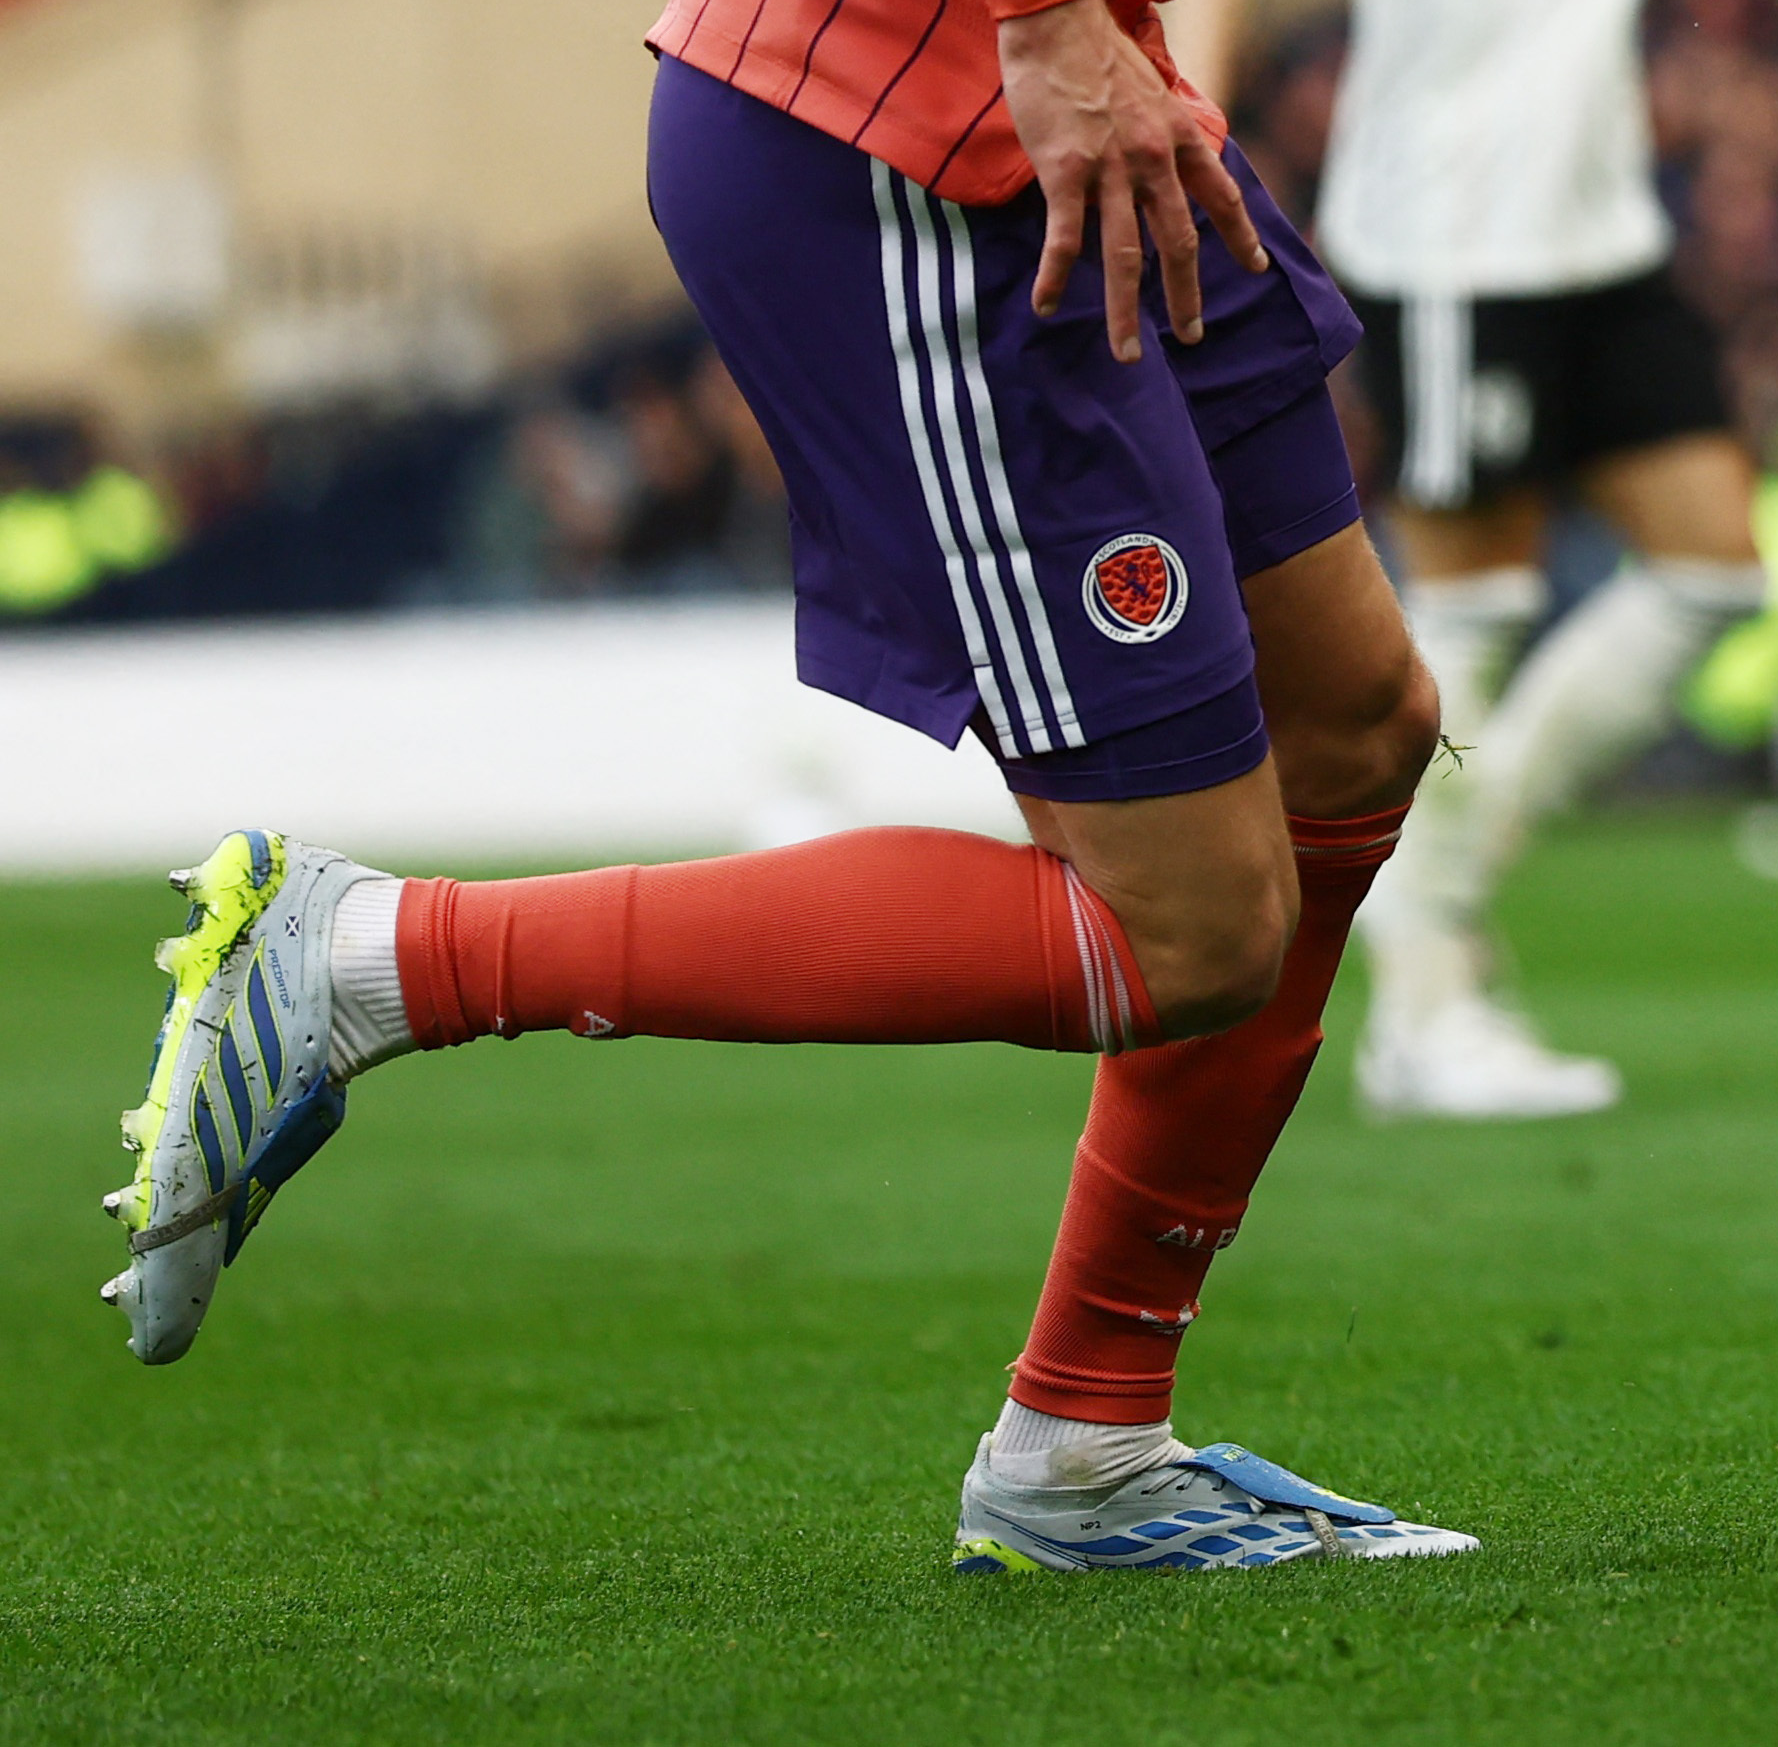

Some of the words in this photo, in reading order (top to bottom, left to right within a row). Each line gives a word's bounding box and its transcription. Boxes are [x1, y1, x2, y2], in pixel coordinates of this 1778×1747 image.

[1098, 536, 1149, 558] SCOTLAND
[268, 948, 291, 1009] PREDATOR
[1080, 1520, 1102, 1531] NP2
